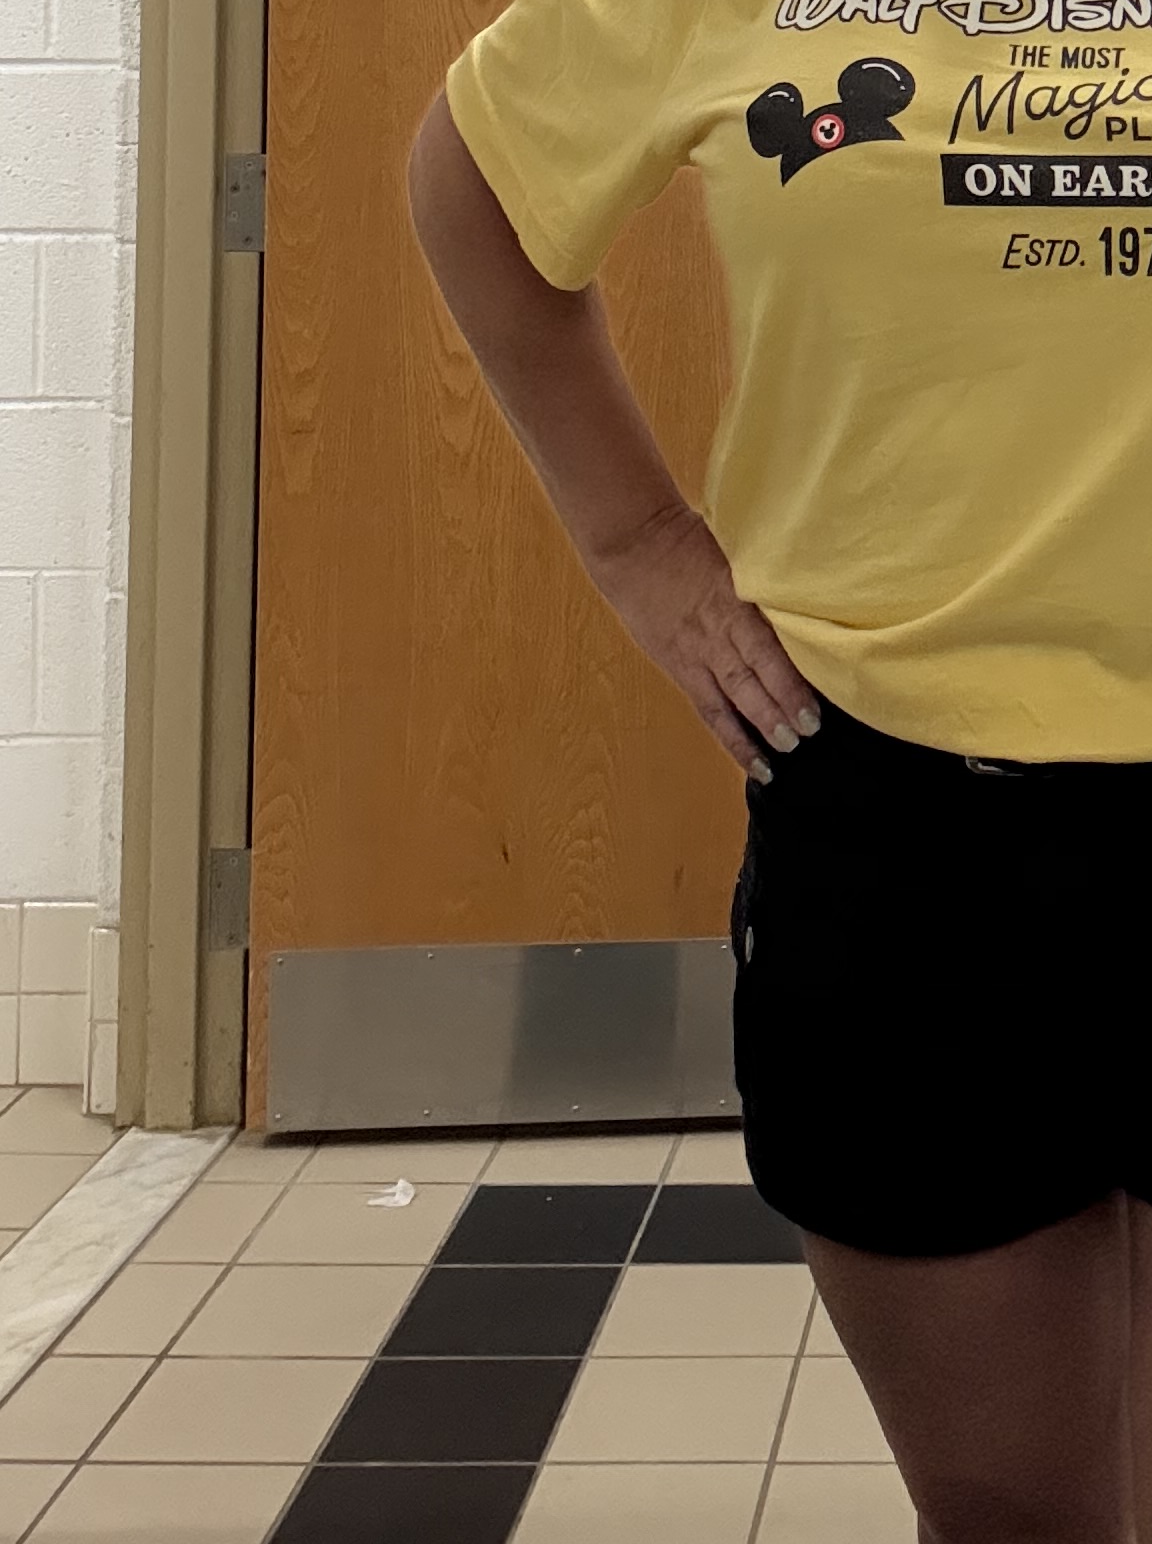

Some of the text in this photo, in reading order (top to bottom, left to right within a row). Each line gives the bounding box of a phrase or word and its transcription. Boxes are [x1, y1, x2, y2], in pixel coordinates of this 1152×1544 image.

[1009, 44, 1127, 69] THE MOST
[964, 163, 1034, 197] ON
